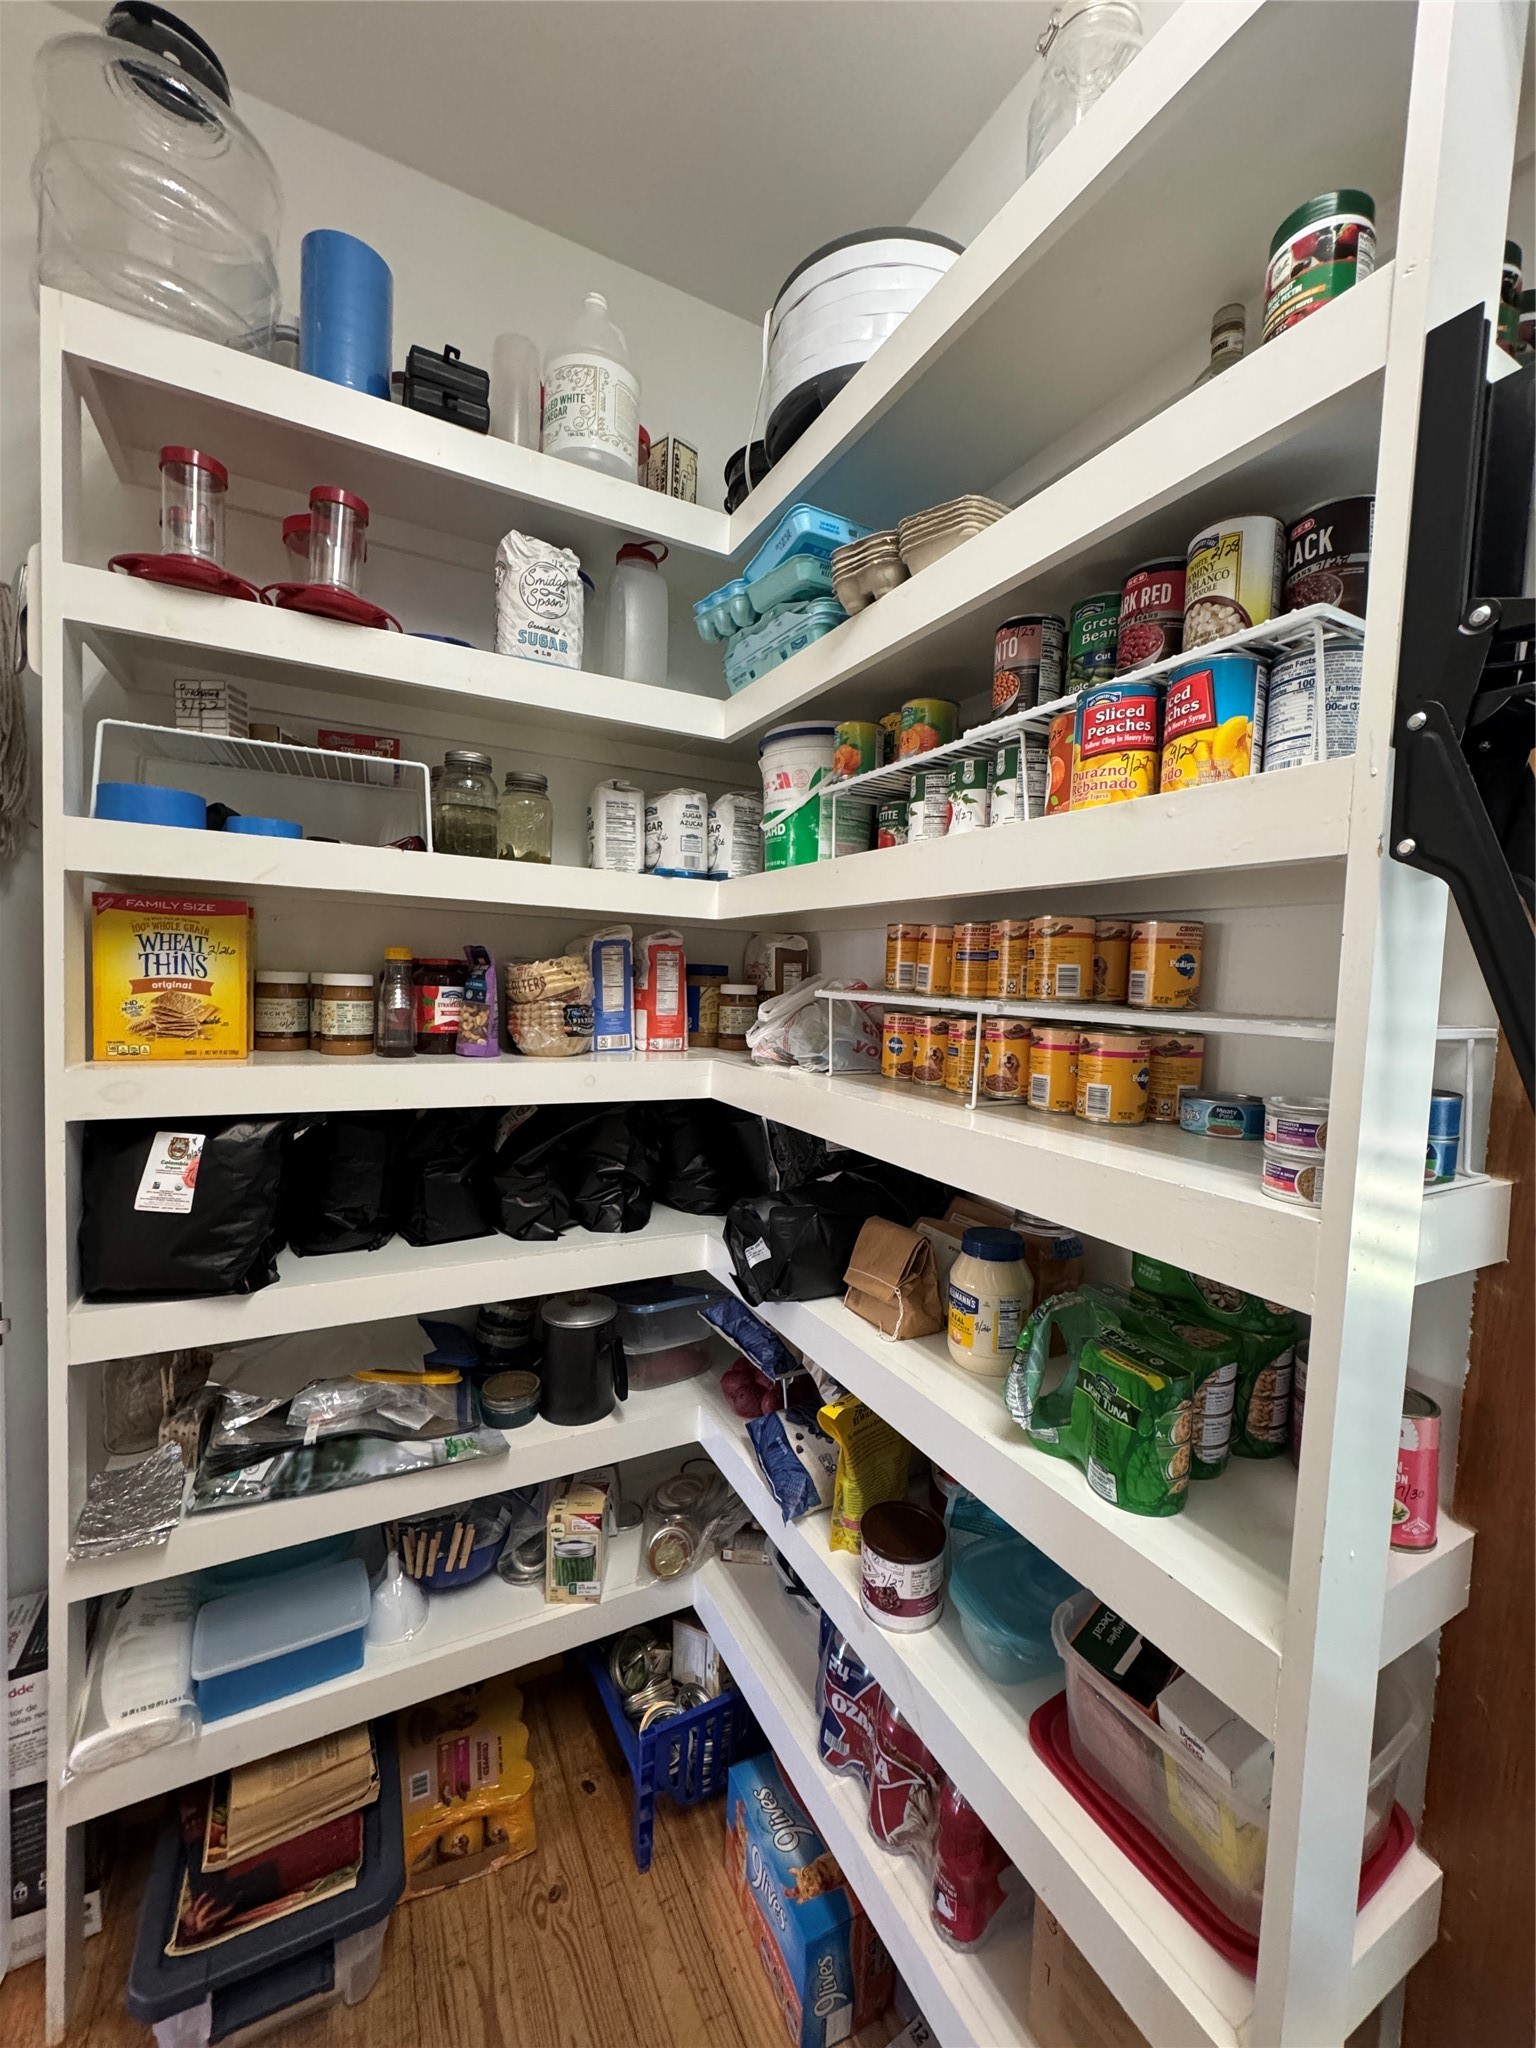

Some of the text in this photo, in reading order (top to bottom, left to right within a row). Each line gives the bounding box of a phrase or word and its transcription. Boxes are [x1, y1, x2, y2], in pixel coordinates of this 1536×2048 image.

[560, 394, 585, 405] WHITE
[1190, 556, 1209, 572] WHITE
[525, 568, 568, 590] Smidge
[1191, 568, 1230, 596] BLANCO
[527, 589, 564, 610] Spoon
[1139, 582, 1172, 608] RED
[1193, 582, 1217, 601] POZOLE
[528, 621, 560, 636] Granulated
[518, 629, 568, 654] SUGAR
[1095, 652, 1111, 661] Cut
[1295, 656, 1316, 668] Facts
[1068, 682, 1089, 695] Ejote
[1297, 678, 1316, 689] 100
[1095, 704, 1145, 723] Sliced
[1188, 713, 1207, 724] Syrup
[1088, 720, 1151, 740] Peaches
[1085, 741, 1100, 750] Yellow
[1101, 738, 1116, 746] Cling
[1124, 734, 1142, 742] Heavy
[1073, 766, 1127, 783] Durazno
[1072, 777, 1137, 795] Rebanado
[126, 899, 216, 912] FAMILY SIZE
[152, 922, 181, 932] WHOLE
[183, 923, 210, 936] GRAIN
[135, 932, 209, 955] WHEAT
[152, 982, 192, 990] original
[1216, 1107, 1238, 1116] Meaty
[161, 1159, 189, 1167] Colombia
[952, 1312, 965, 1325] REAL
[1083, 1378, 1129, 1423] LIGHT TUNA
[880, 1572, 904, 1588] 9/27
[1092, 1611, 1117, 1640] Decaf
